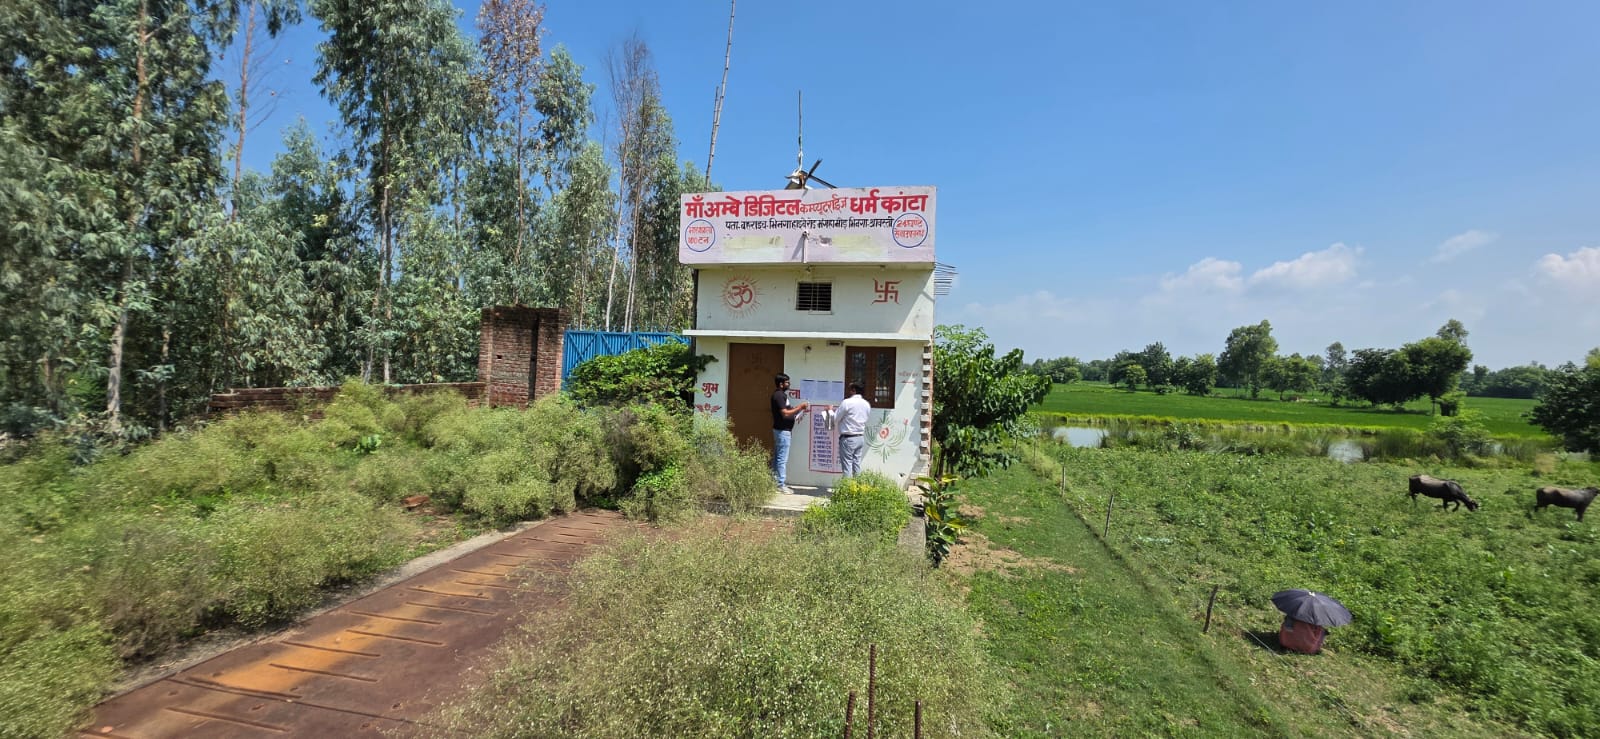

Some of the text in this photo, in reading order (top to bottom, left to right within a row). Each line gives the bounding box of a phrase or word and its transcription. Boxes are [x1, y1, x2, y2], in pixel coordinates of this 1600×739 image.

[685, 195, 704, 218] माँ
[743, 195, 801, 217] डिजिटल
[850, 189, 880, 215] धर्म
[880, 191, 928, 213] कांटा
[702, 383, 719, 398] शुभ
